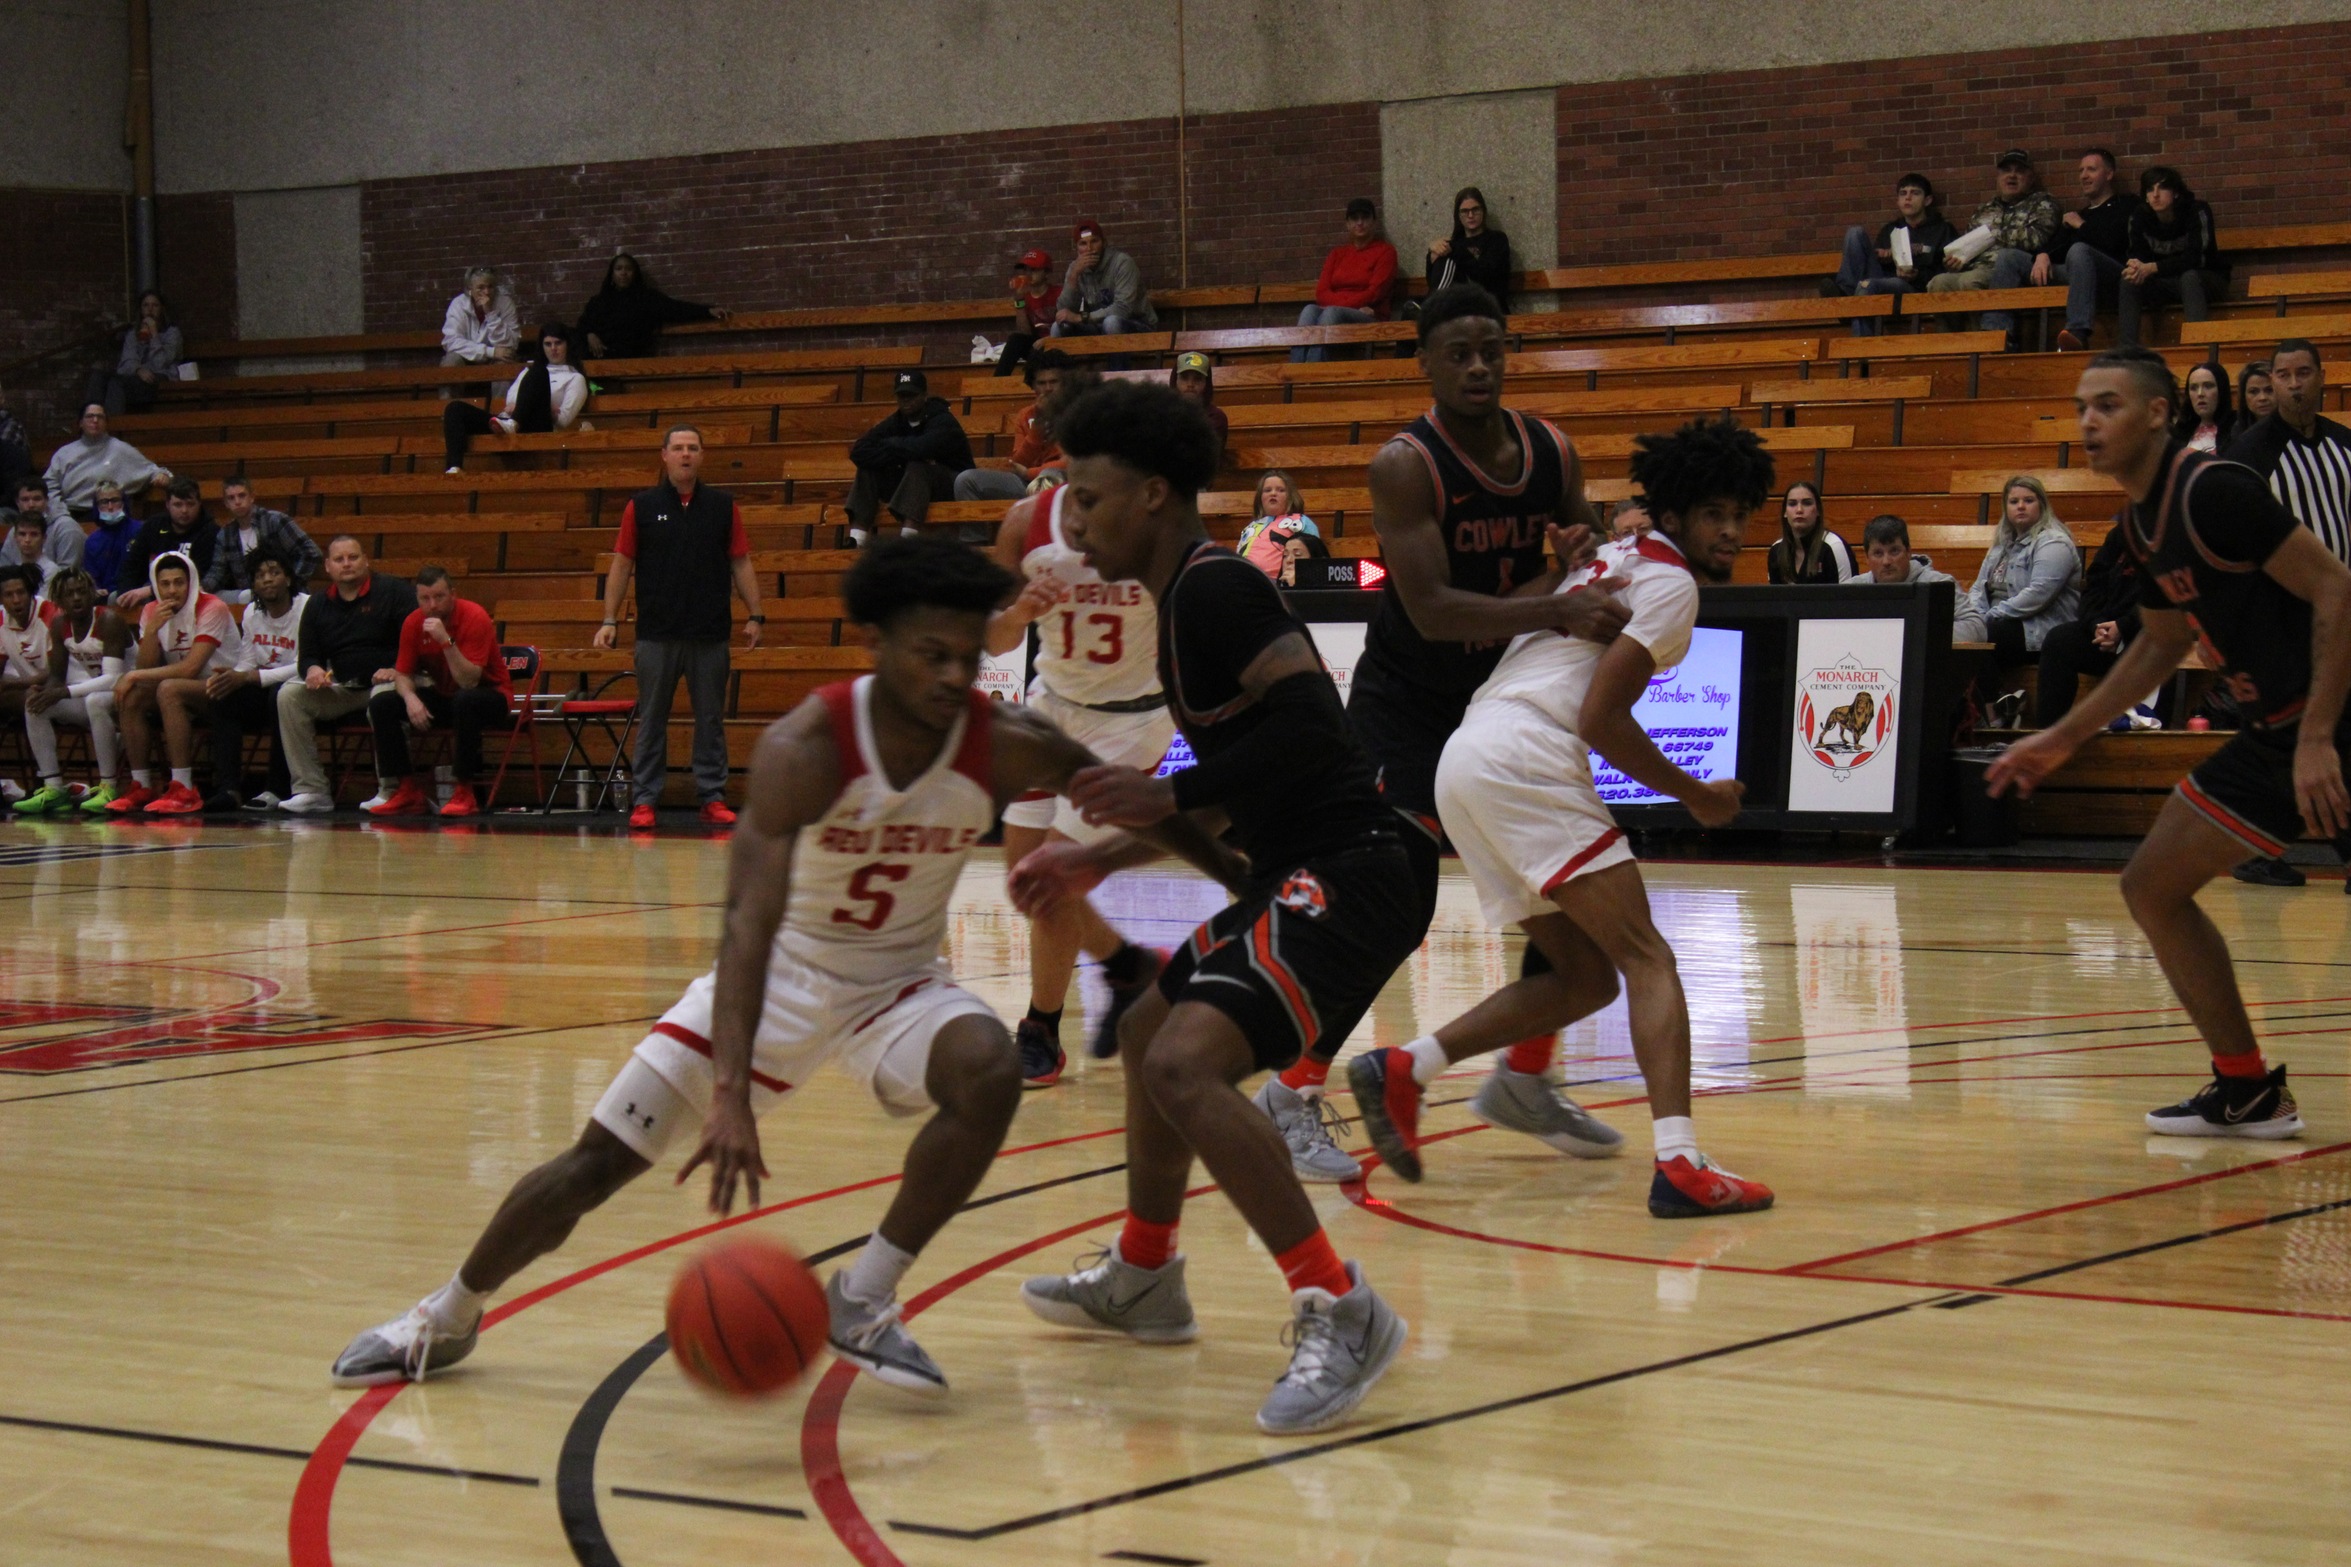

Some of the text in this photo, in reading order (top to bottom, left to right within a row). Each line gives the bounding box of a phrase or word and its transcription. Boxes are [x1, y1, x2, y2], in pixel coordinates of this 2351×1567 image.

[1327, 565, 1356, 582] POSS.
[1075, 583, 1141, 606] DEVILS
[252, 634, 296, 651] ALLEN
[1060, 610, 1123, 665] 13
[1816, 671, 1879, 683] MONARCH
[1810, 683, 1887, 691] CEMENT COMPANY
[1649, 684, 1732, 711] Barber Shop
[1662, 741, 1714, 754] 66749
[831, 861, 912, 932] 5
